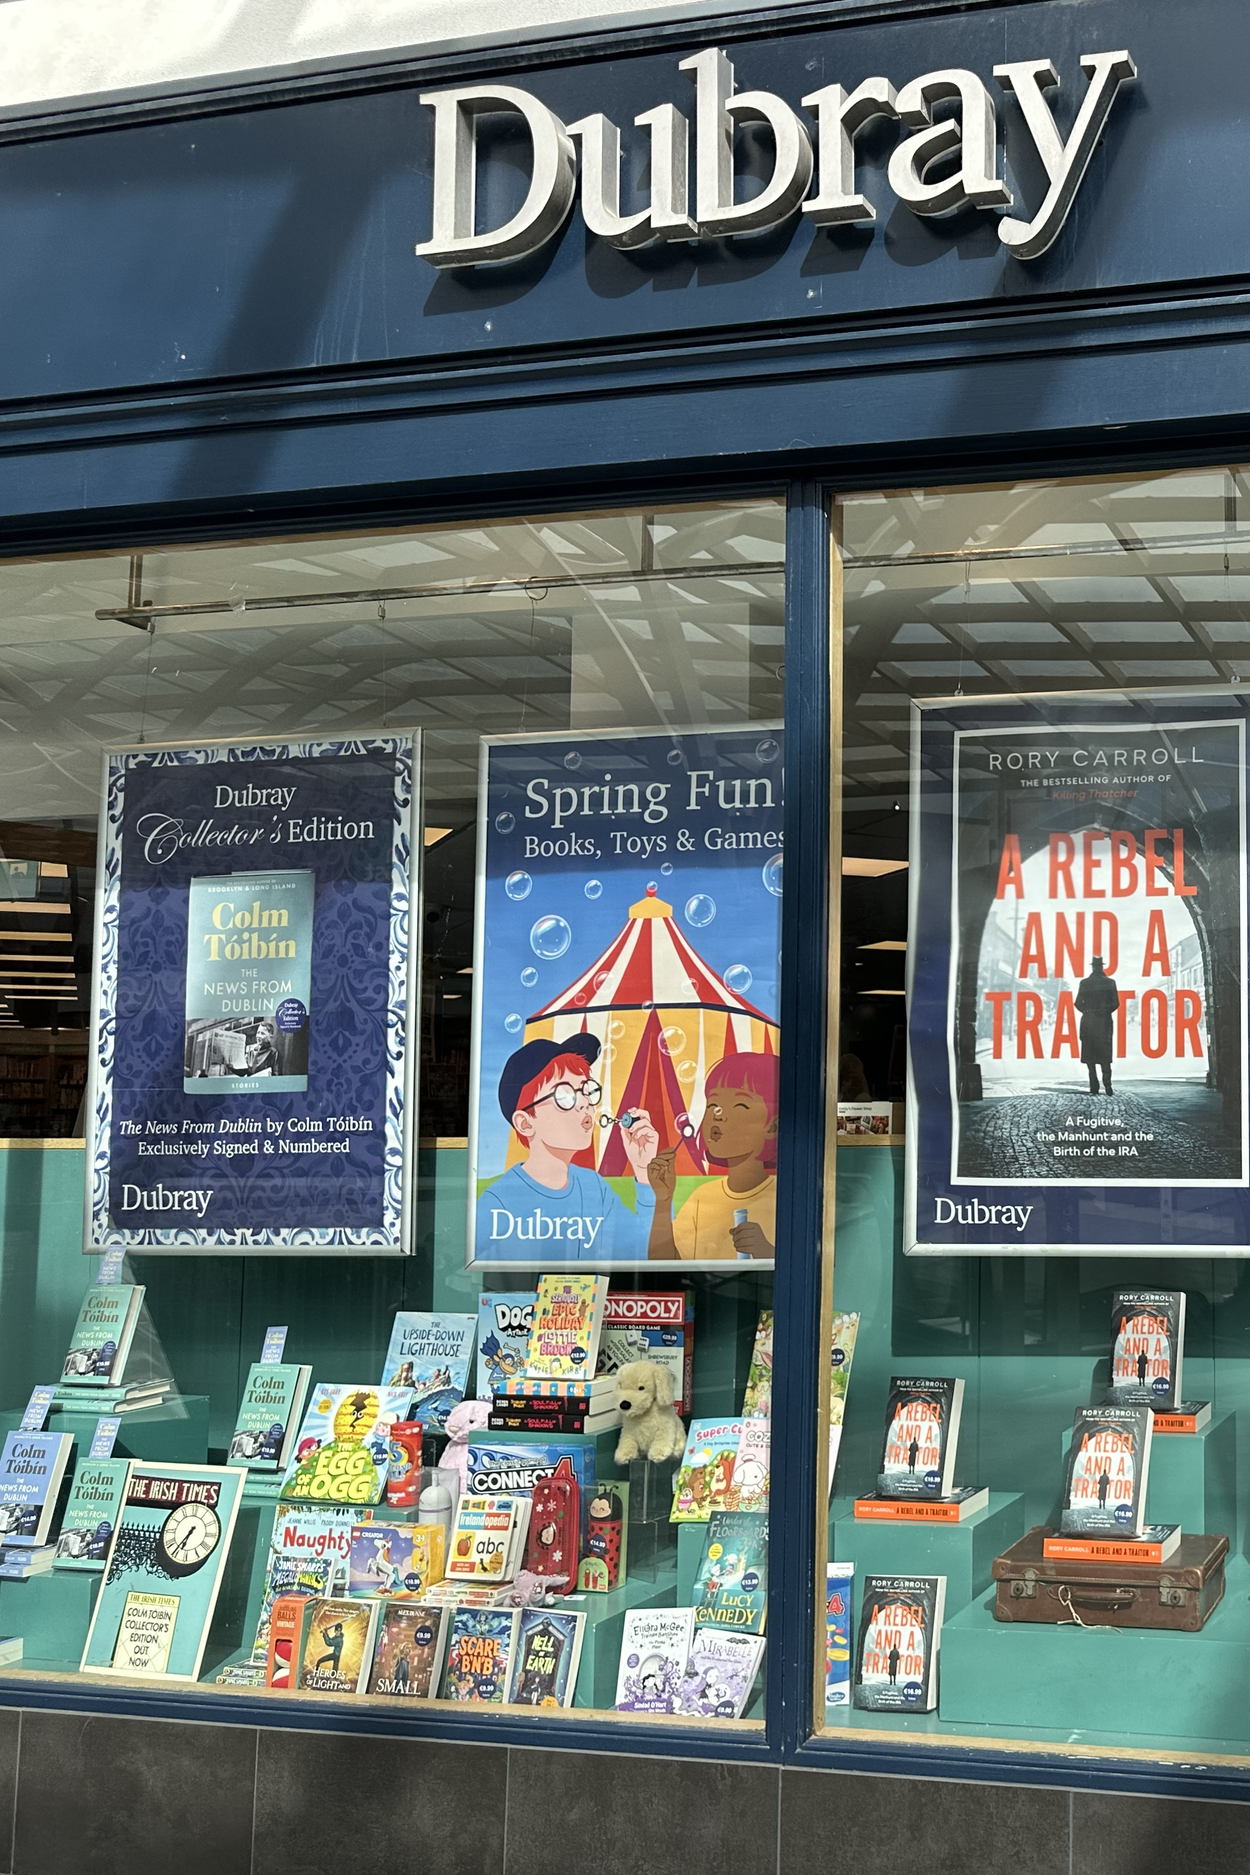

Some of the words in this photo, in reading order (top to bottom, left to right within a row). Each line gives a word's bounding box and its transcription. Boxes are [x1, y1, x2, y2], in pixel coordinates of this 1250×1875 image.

[415, 47, 1138, 260] Dubray
[989, 750, 1060, 771] RORY
[1073, 746, 1205, 767] CARROLL
[1020, 778, 1039, 788] THE
[1042, 775, 1110, 787] BESTSELLING
[1112, 774, 1155, 785] AUTHOR
[1158, 773, 1172, 783] OF
[214, 783, 297, 812] Dubray
[524, 773, 672, 829] Spring
[1052, 789, 1087, 801] Killing
[1088, 787, 1140, 800] Thatcher
[136, 812, 283, 866] Collector's
[287, 815, 375, 843] Edition
[524, 832, 602, 859] Books,
[610, 830, 667, 859] Toys
[676, 828, 696, 851] &
[704, 827, 784, 851] Games
[995, 833, 1026, 901] A
[1048, 827, 1199, 899] REBEL
[271, 882, 296, 891] ISLAND
[211, 900, 290, 931] Colm
[203, 931, 297, 962] Tóibín
[1018, 908, 1119, 980] AND
[1141, 908, 1172, 978] A
[240, 967, 259, 979] THE
[203, 981, 248, 996] NEWS
[252, 979, 293, 995] FROM
[221, 998, 275, 1013] DUBLIN
[984, 988, 1205, 1060] TRATOR
[231, 1081, 260, 1090] STORIES
[119, 1119, 143, 1136] The
[145, 1120, 178, 1135] News
[181, 1119, 216, 1134] From
[218, 1118, 263, 1134] Dublin
[266, 1117, 284, 1136] by
[287, 1117, 323, 1133] Colm
[326, 1115, 374, 1132] Tóibín
[1065, 1116, 1075, 1127] A
[1076, 1115, 1125, 1130] Fugitive,
[1036, 1131, 1056, 1142] the
[1057, 1130, 1110, 1142] Manhunt
[1110, 1130, 1134, 1142] and
[1134, 1130, 1154, 1142] the
[137, 1140, 211, 1158] Exclusively
[213, 1139, 259, 1158] Signed
[263, 1139, 275, 1154] &
[278, 1138, 351, 1154] Numbered
[1053, 1146, 1081, 1158] Birth
[1082, 1145, 1096, 1157] of
[1096, 1145, 1117, 1157] the
[1118, 1145, 1140, 1157] IRA
[121, 1182, 214, 1218] Dubray
[933, 1197, 1034, 1233] Dubray
[489, 1207, 604, 1250] Dubray
[603, 1300, 679, 1318] ONOPOLY
[402, 1328, 466, 1342] UPSIDE-DOWN
[399, 1342, 462, 1358] LIGHTHOUSE
[314, 1450, 369, 1476] EGG
[292, 1485, 311, 1497] AN
[309, 1474, 372, 1501] OGG
[296, 1474, 313, 1486] OF
[128, 1478, 150, 1498] THE
[149, 1480, 179, 1502] IRISH
[182, 1483, 220, 1505] TIMES
[460, 1513, 511, 1528] Irelandopedia
[283, 1526, 351, 1560] Naughty
[475, 1536, 505, 1555] abc
[127, 1607, 148, 1618] COLM
[129, 1632, 159, 1644] EDITION
[459, 1635, 502, 1658] SCARE
[699, 1638, 754, 1658] MIRABELLE
[133, 1645, 150, 1656] OUT
[128, 1656, 150, 1668] NOW
[375, 1678, 421, 1695] SMALL
